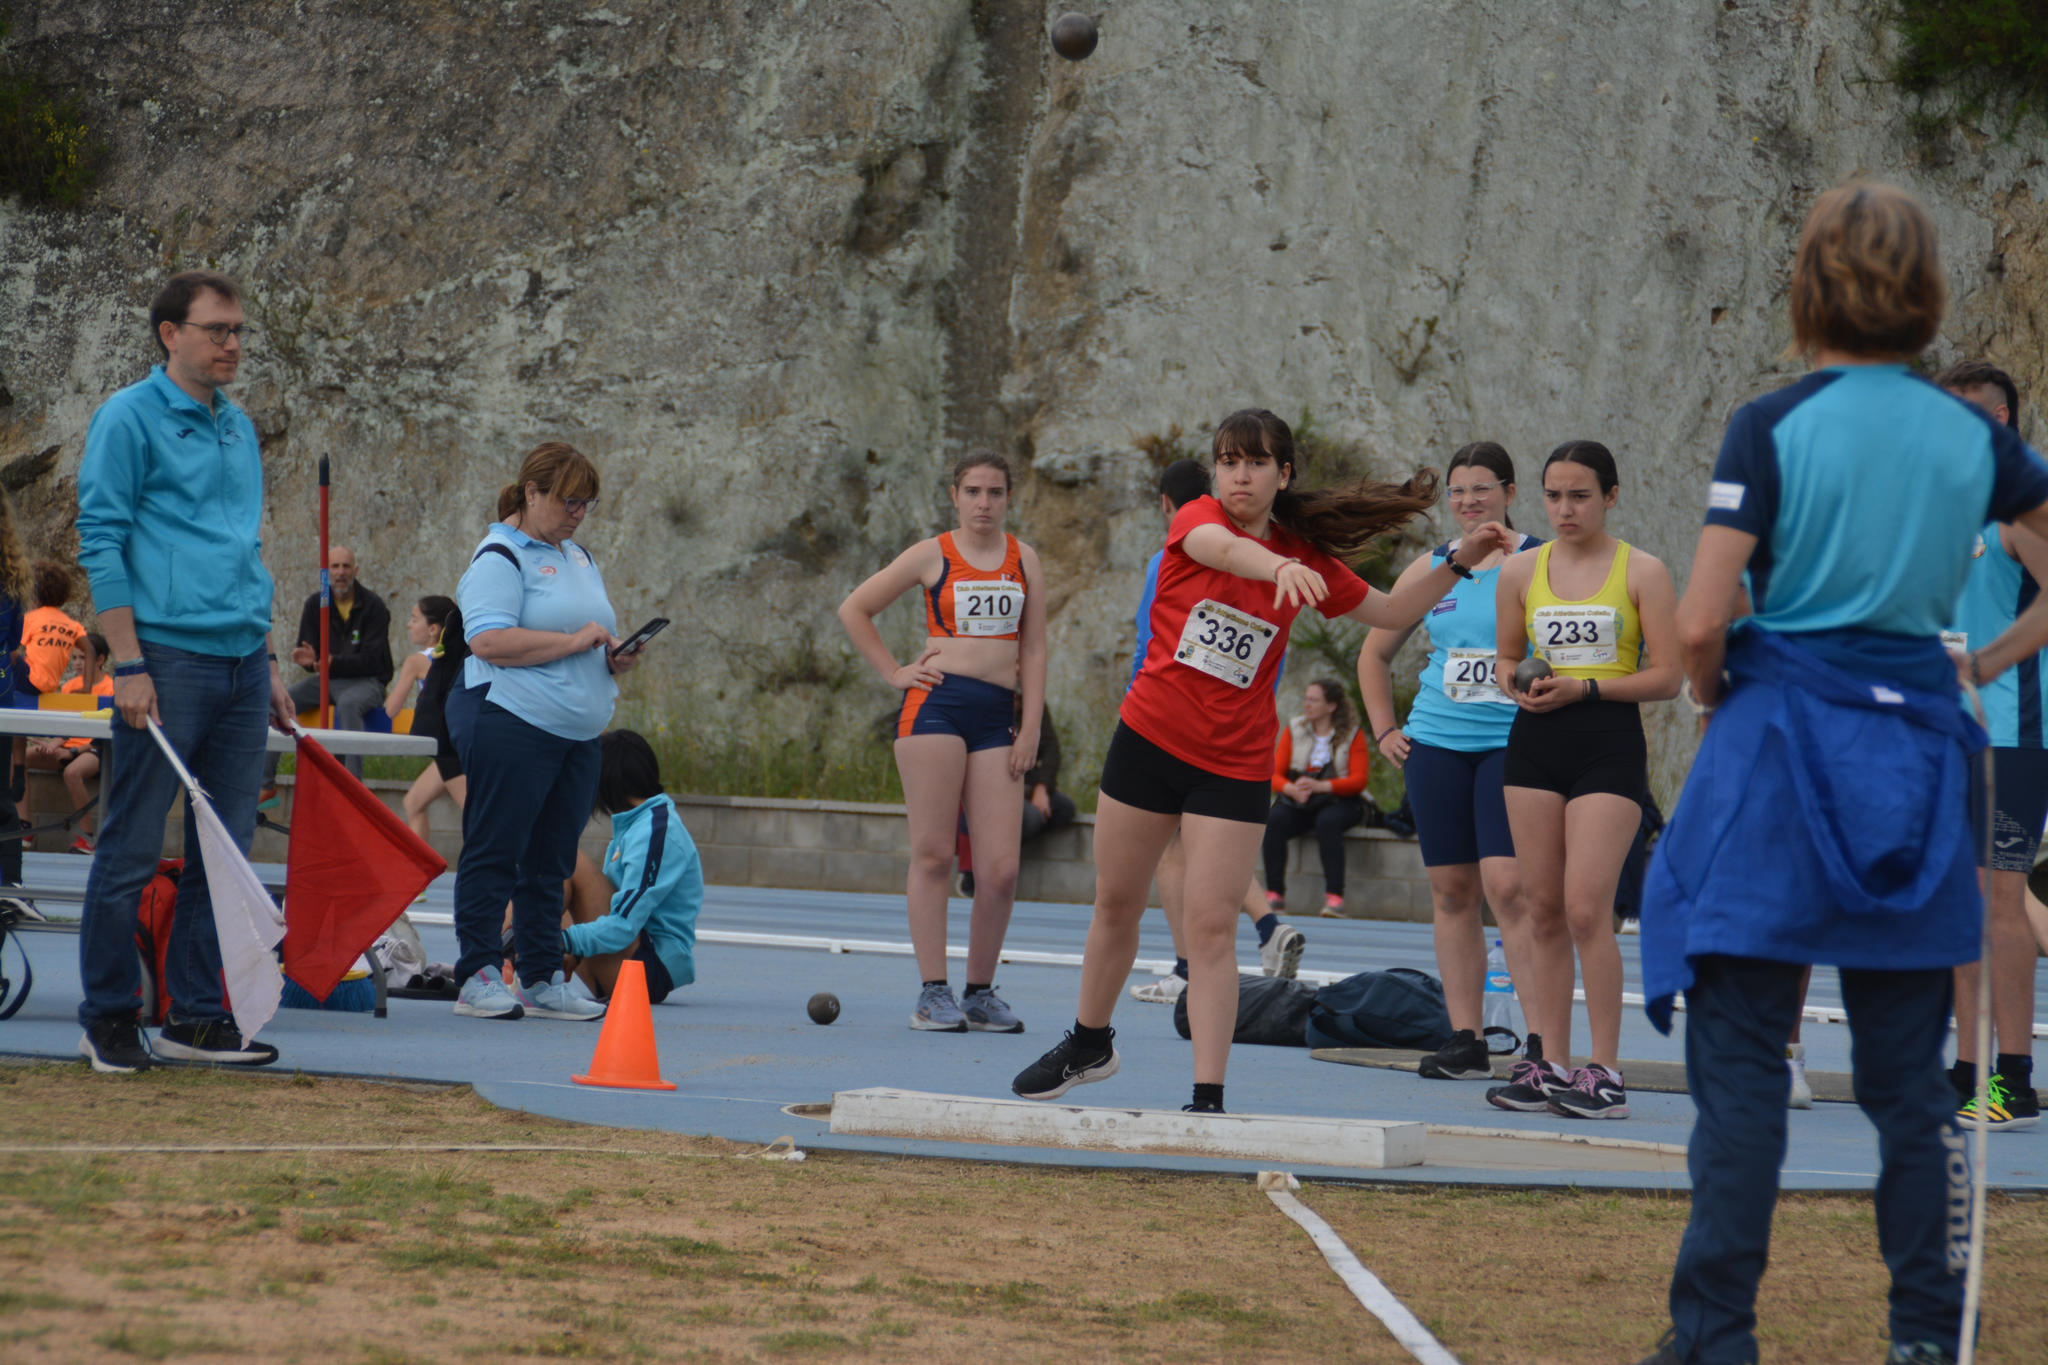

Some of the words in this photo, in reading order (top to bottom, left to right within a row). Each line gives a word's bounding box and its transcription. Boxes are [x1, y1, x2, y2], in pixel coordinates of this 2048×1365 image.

[968, 595, 1012, 616] 210
[1199, 619, 1254, 660] 336
[1547, 620, 1599, 645] 233
